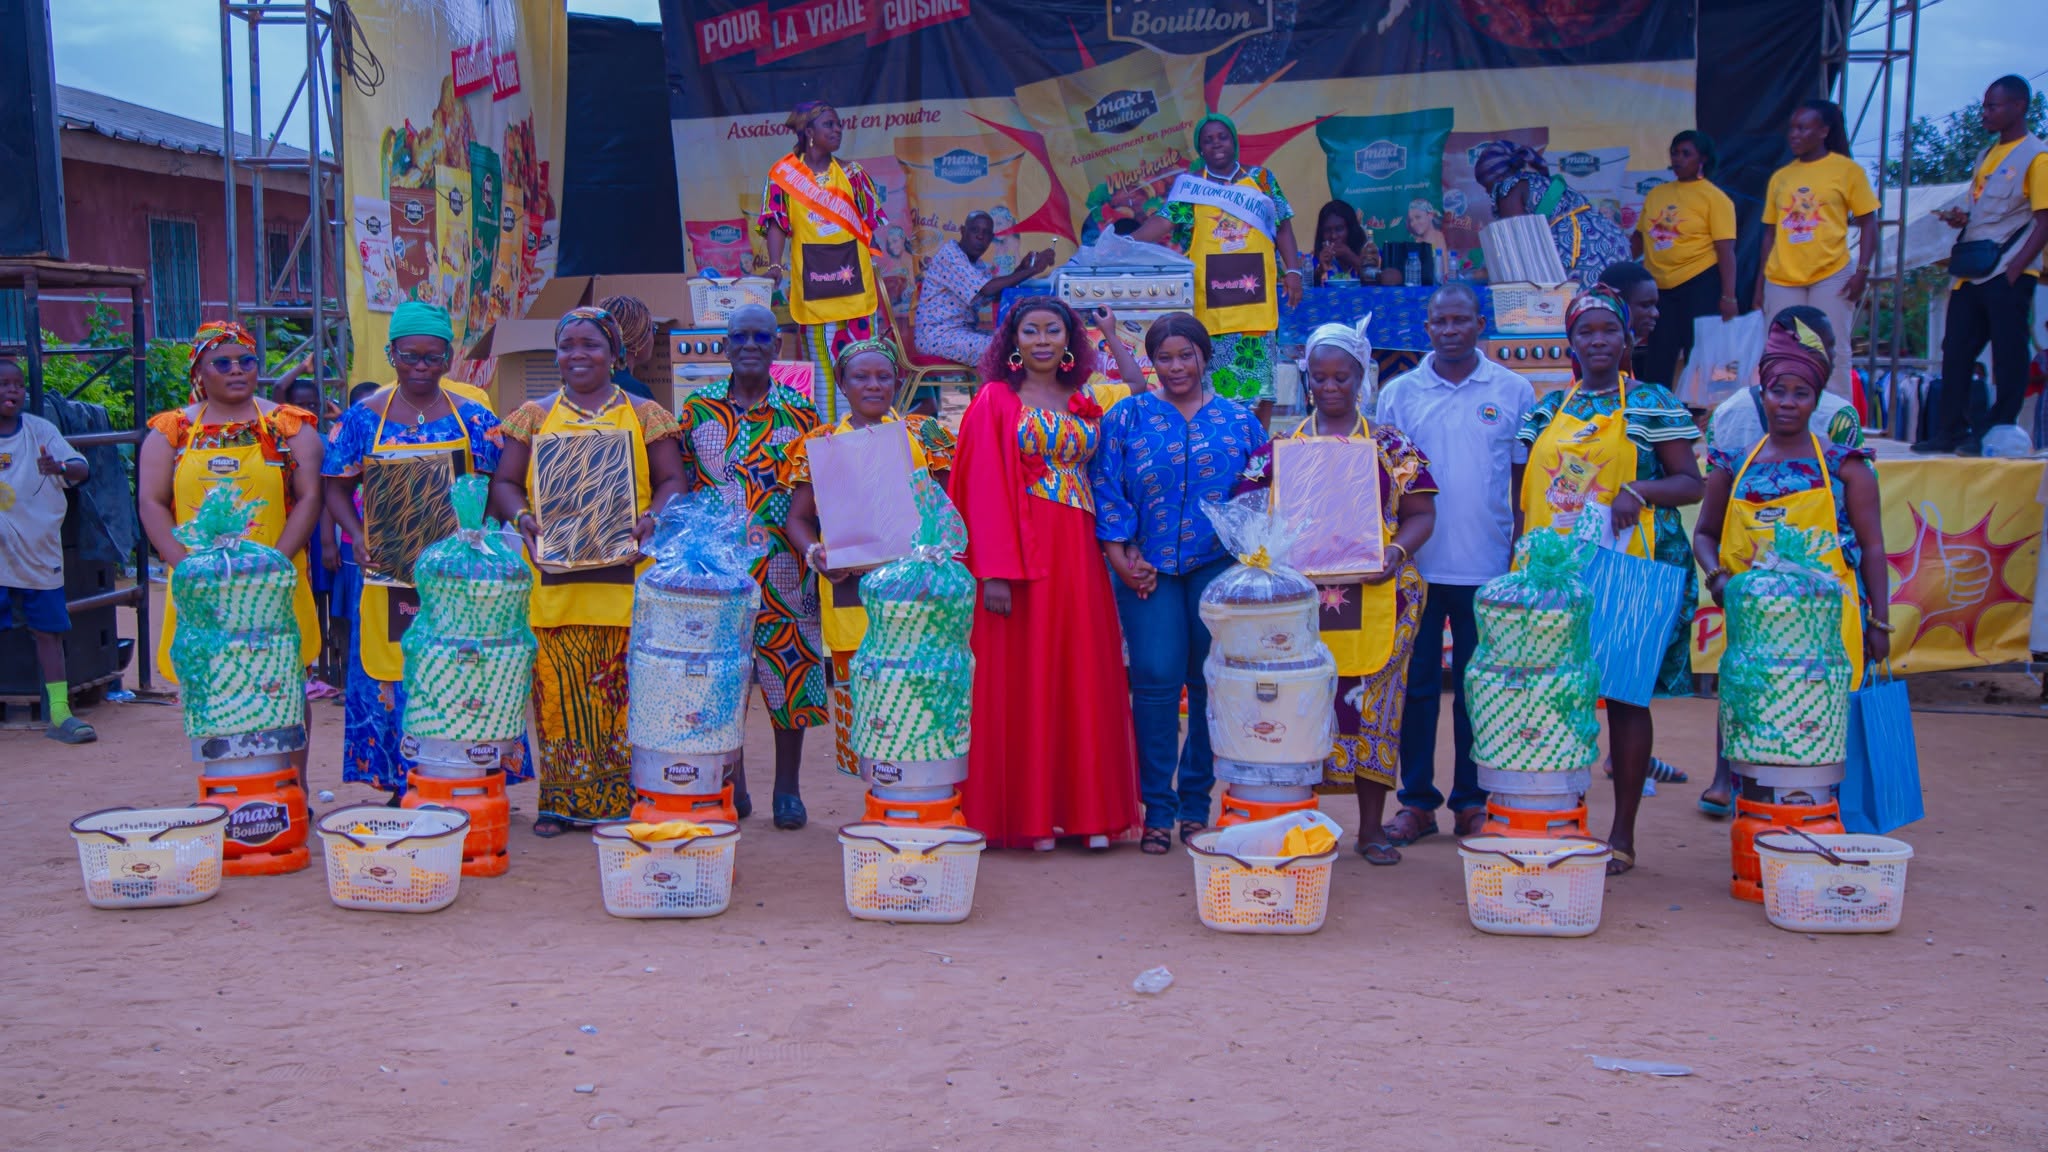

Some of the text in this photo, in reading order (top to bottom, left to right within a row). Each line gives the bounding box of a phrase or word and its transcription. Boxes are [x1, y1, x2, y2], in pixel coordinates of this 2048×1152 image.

[703, 9, 762, 54] POUR
[772, 15, 799, 49] LA
[805, 0, 866, 38] VRAIE
[1130, 7, 1252, 36] Bouillon
[1095, 91, 1144, 117] maxi
[727, 106, 941, 140] Assaisonnt en poudre
[1096, 107, 1151, 131] Bouillon
[942, 155, 980, 166] maxi
[1070, 135, 1144, 167] Assaisonnement
[1146, 133, 1159, 143] en
[1363, 144, 1399, 159] maxi
[1105, 147, 1180, 195] Marinade
[1191, 183, 1202, 196] DU
[1202, 186, 1246, 206] CONCOURS
[471, 745, 495, 755] maxi
[669, 766, 695, 775] maxi
[875, 764, 898, 775] maxi
[232, 801, 280, 825] maxi
[231, 822, 283, 839] Bouillon
